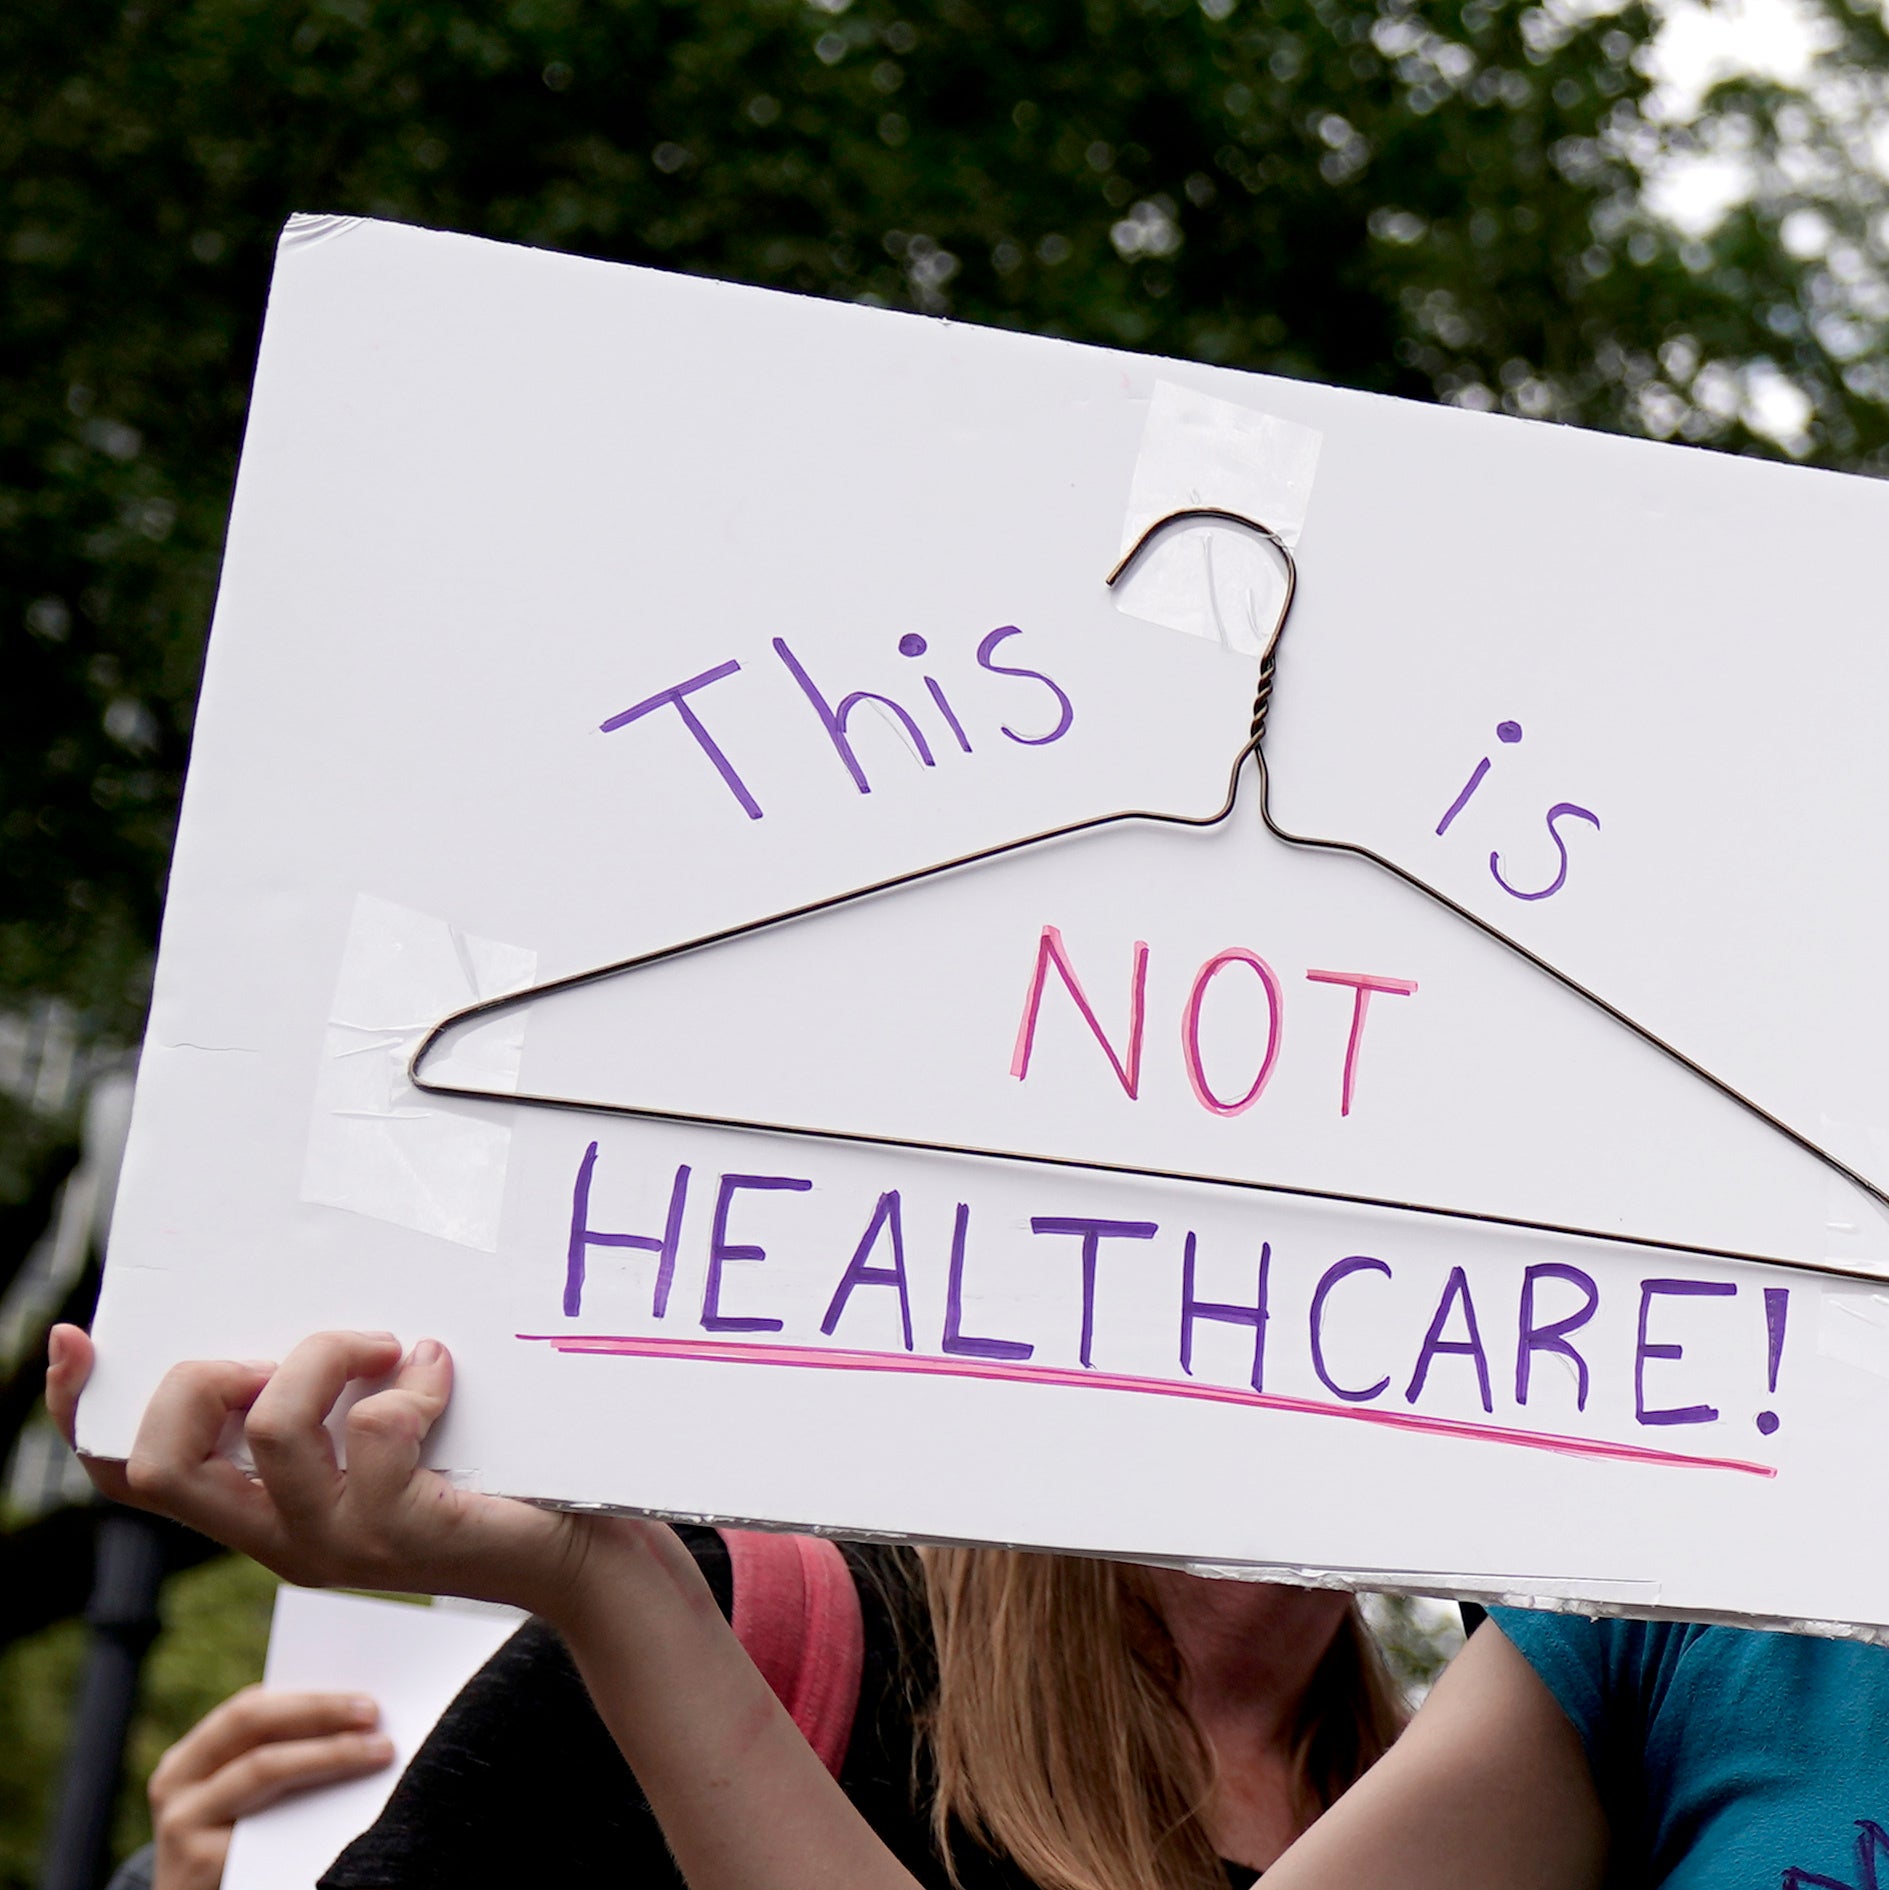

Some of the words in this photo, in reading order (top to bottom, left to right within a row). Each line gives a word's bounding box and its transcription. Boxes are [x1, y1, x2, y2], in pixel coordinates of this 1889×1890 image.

[599, 622, 1077, 821] This
[1432, 719, 1602, 901] is
[1007, 924, 1421, 1120] NOT
[560, 1139, 1792, 1439] HEALTHCARE!
